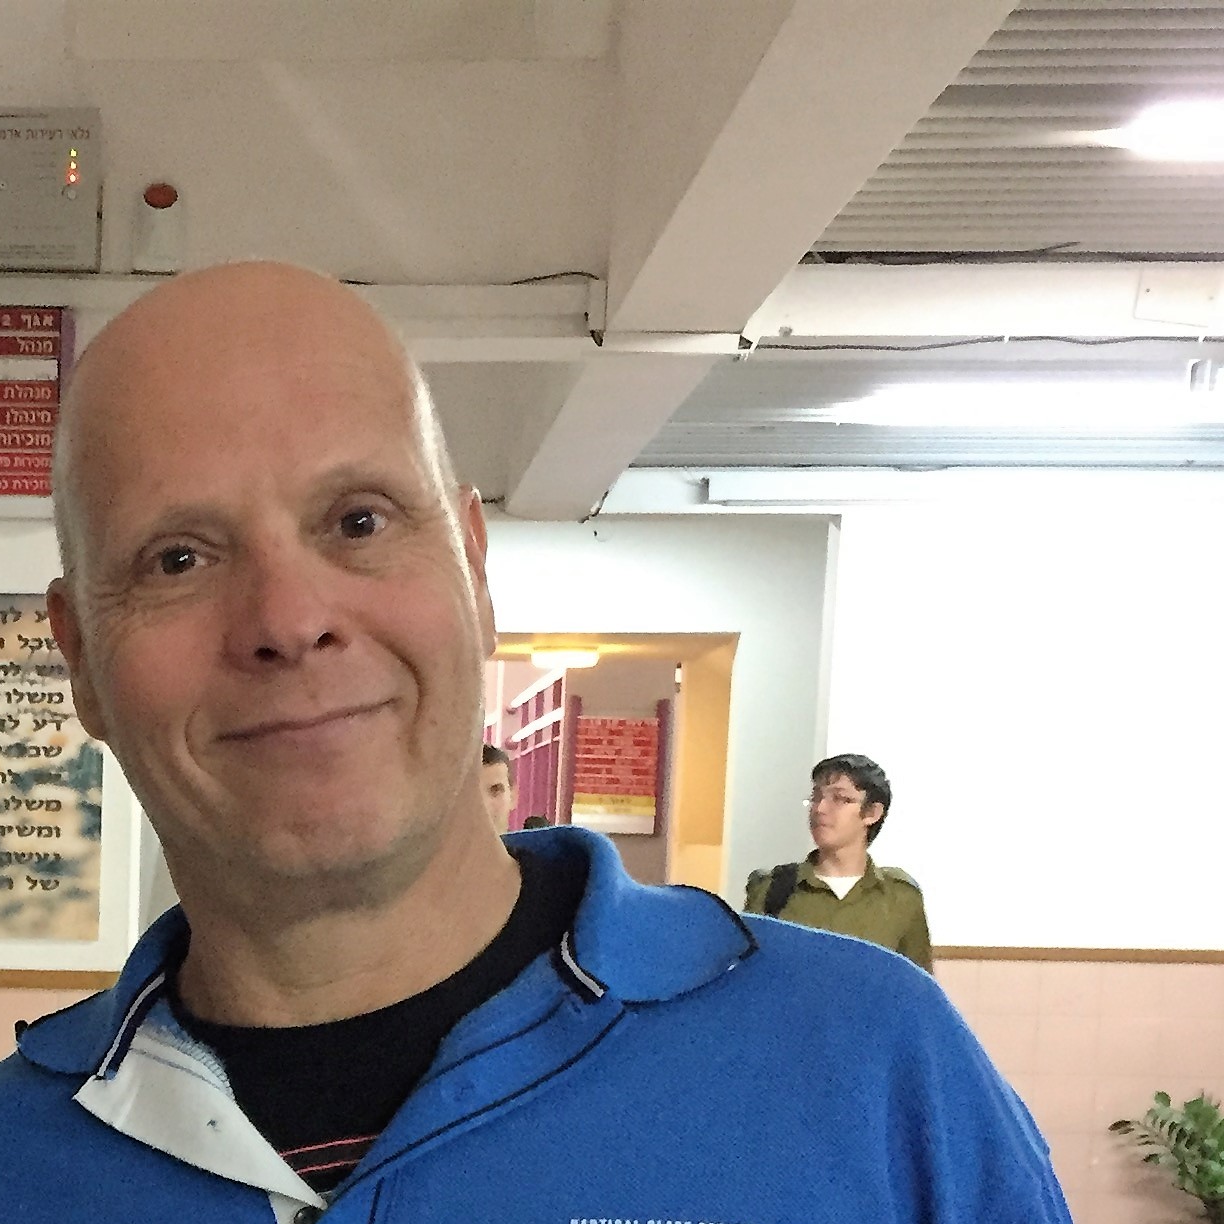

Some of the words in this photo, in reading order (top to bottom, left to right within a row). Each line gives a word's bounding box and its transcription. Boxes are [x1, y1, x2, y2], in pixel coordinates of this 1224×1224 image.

[15, 336, 54, 353] מנהל
[4, 687, 64, 705] משלו
[32, 718, 63, 732] דע
[14, 744, 63, 759] שכ
[3, 795, 62, 812] משלו
[25, 875, 60, 891] של
